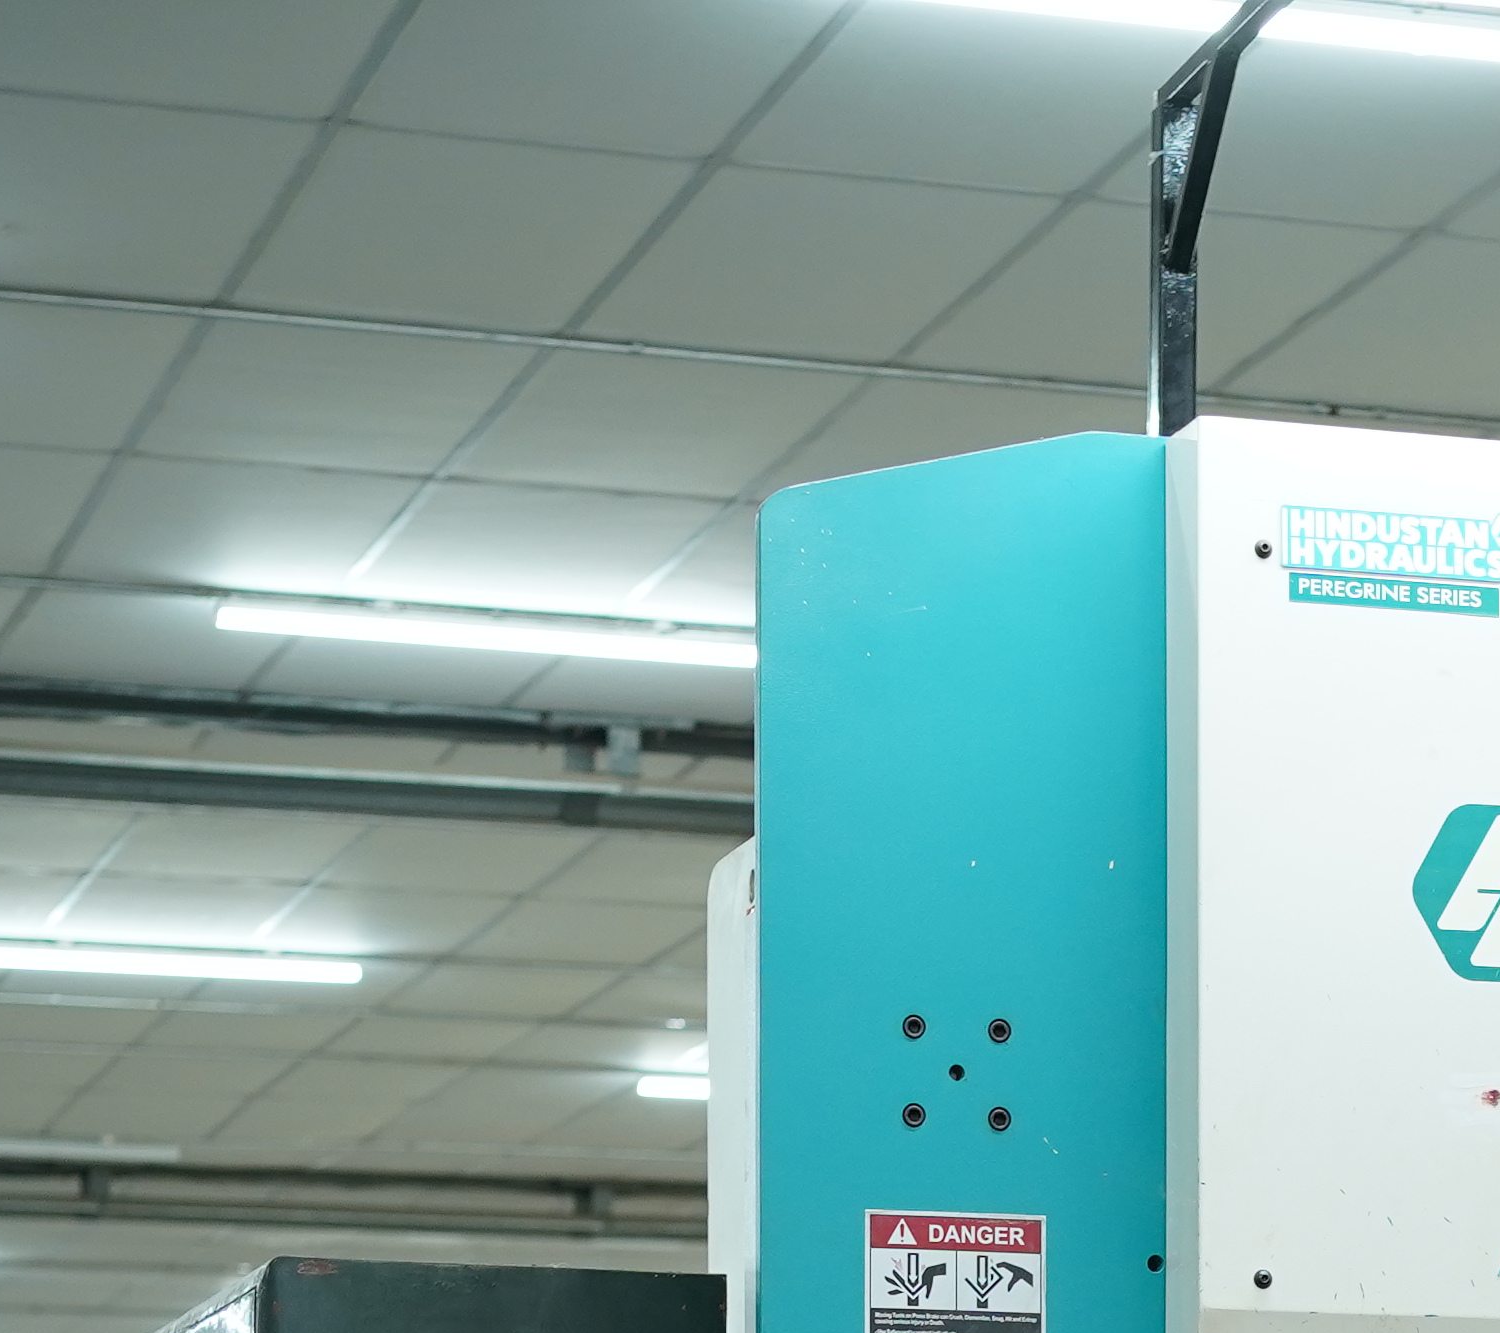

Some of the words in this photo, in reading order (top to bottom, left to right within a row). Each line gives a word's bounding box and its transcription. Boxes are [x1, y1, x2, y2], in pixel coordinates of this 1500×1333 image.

[1290, 507, 1490, 550] HINDUSTAN
[1297, 577, 1411, 603] PEREGRINE
[1417, 586, 1483, 608] SERIES
[928, 1223, 1026, 1247] DANGER
